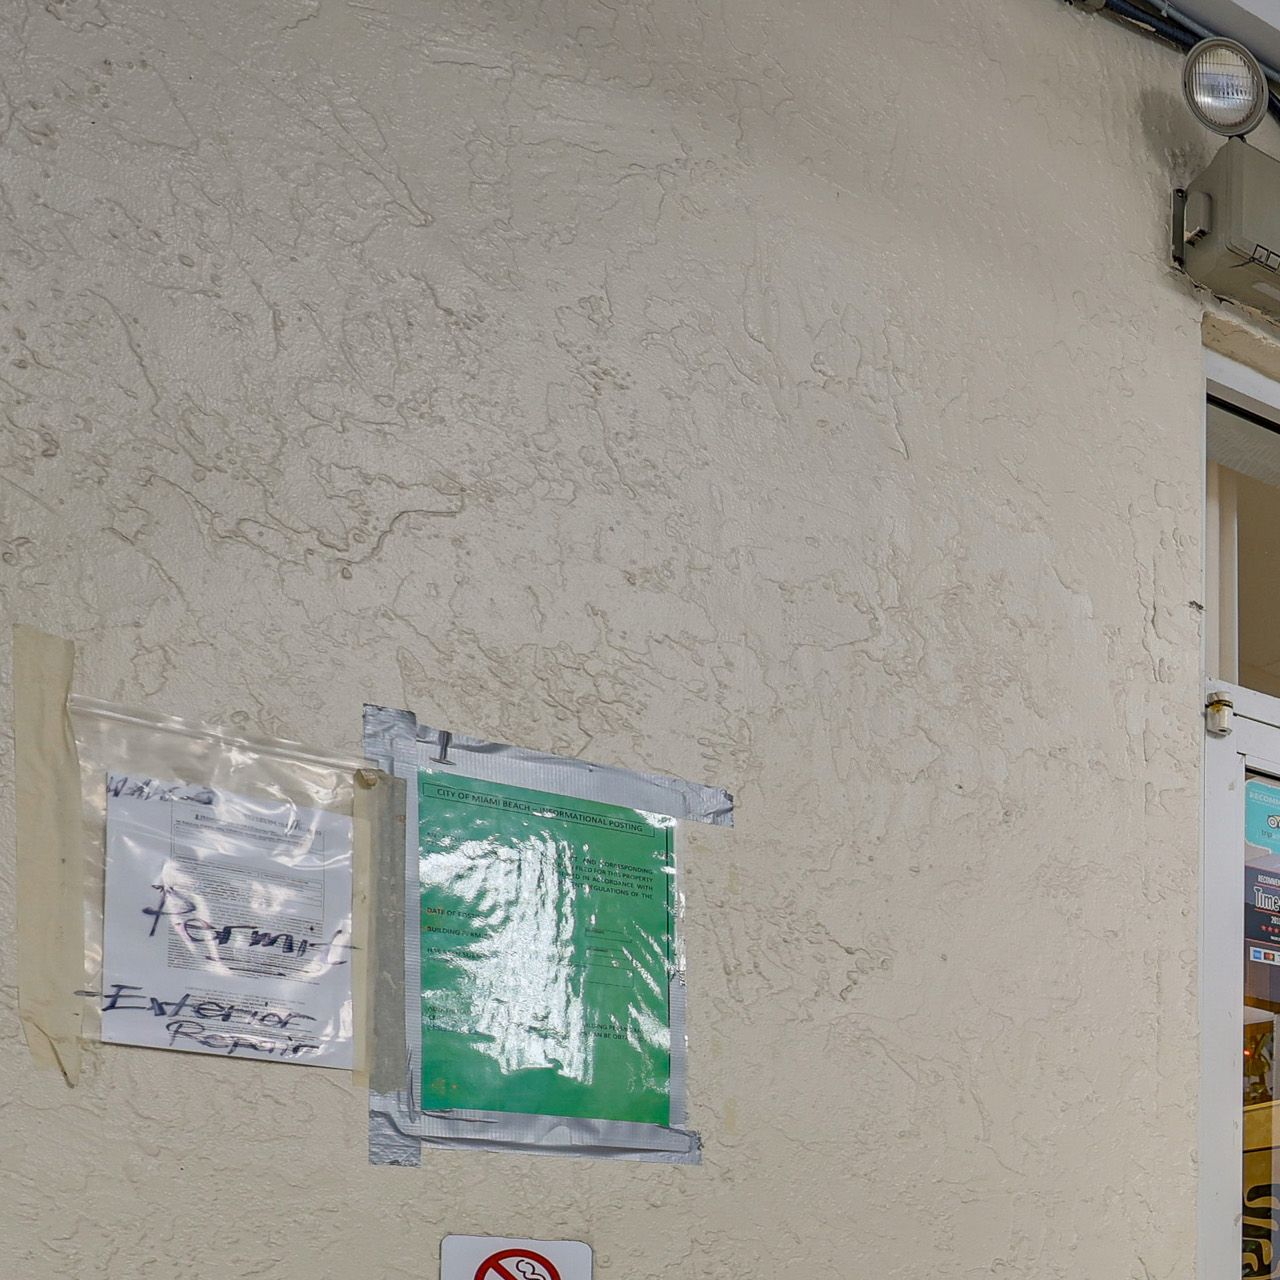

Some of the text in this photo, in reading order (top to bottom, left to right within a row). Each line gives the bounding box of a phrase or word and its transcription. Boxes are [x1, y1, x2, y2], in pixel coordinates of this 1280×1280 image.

[437, 788, 456, 799] CITY
[458, 792, 470, 800] OF
[472, 794, 500, 806] MIAMI
[503, 800, 530, 812] BEACH
[609, 820, 643, 832] POSTING
[142, 884, 361, 966] Permit
[101, 984, 317, 1028] Exterior
